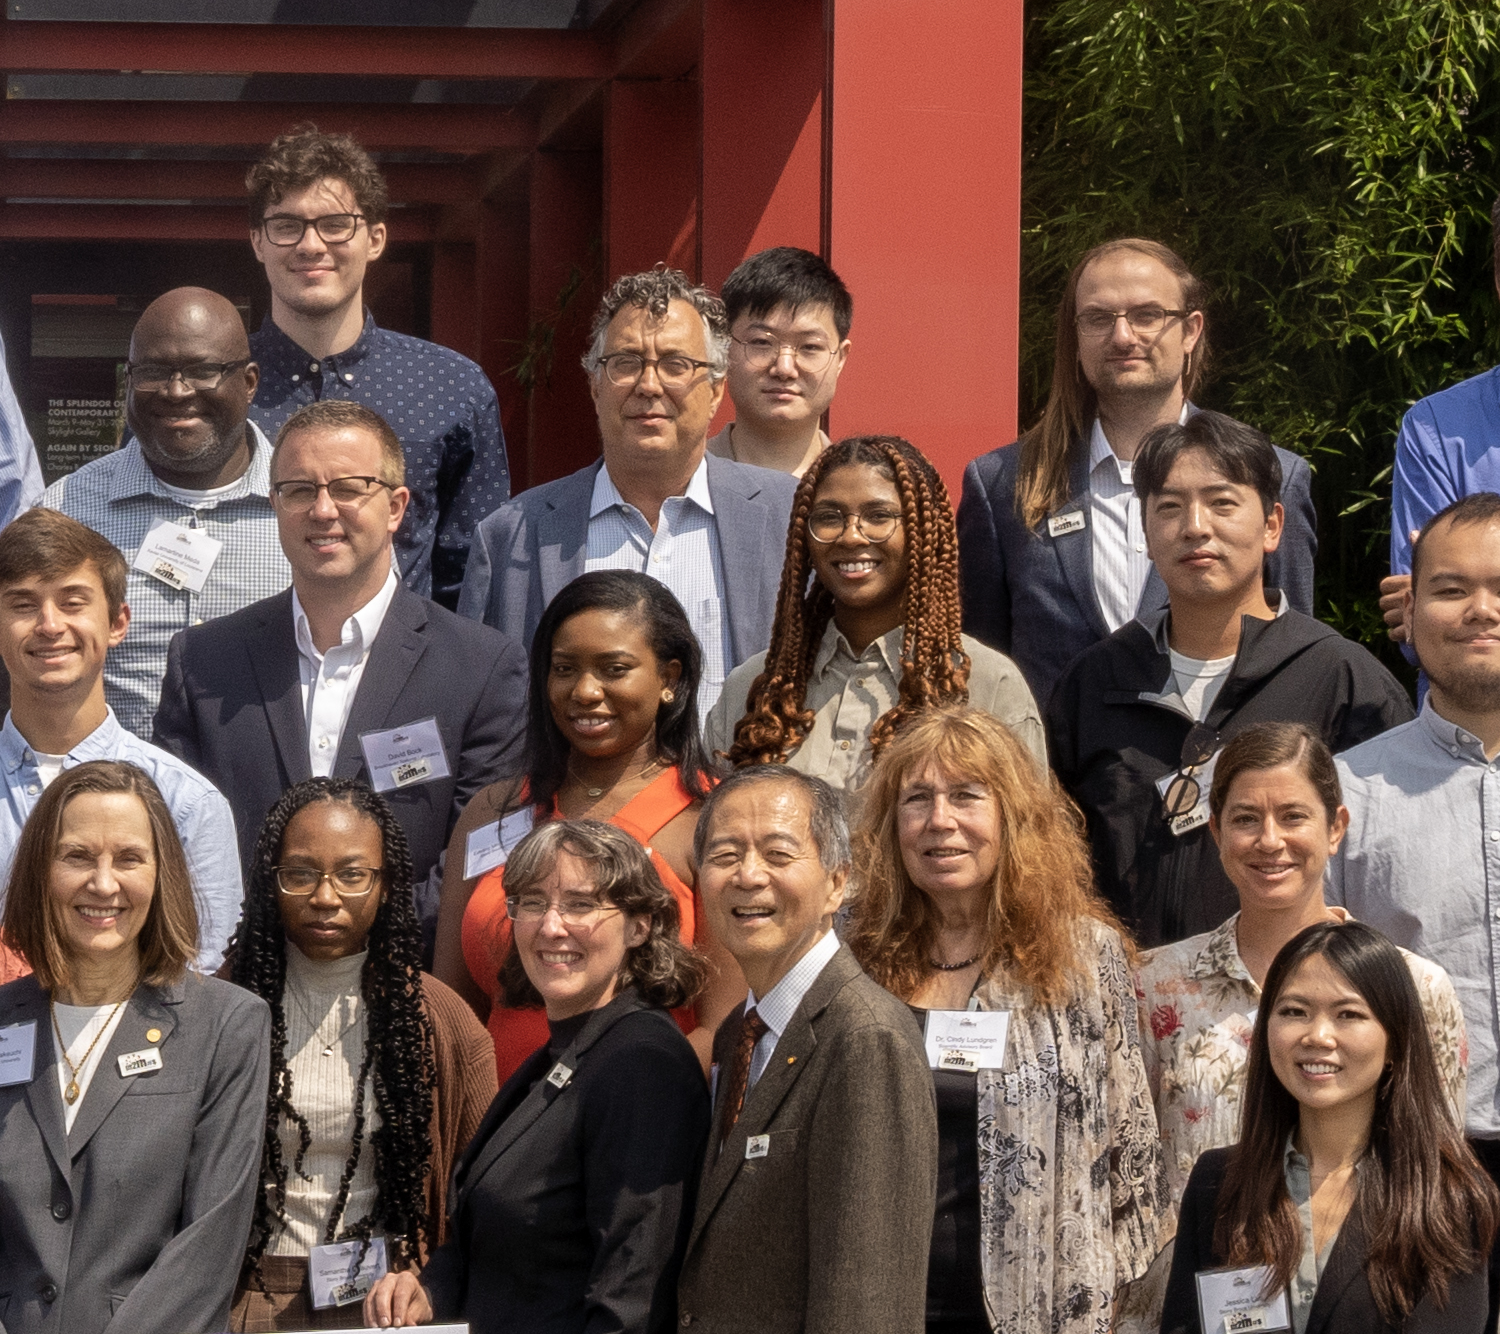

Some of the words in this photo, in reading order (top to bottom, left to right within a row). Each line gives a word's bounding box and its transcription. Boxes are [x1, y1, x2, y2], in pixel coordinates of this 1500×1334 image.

[48, 399, 64, 407] THE
[66, 399, 111, 407] SPLENDOR
[48, 409, 120, 417] CONTEMPORARY
[79, 444, 91, 452] BY
[155, 543, 184, 558] Lamartine
[387, 750, 406, 761] David
[935, 1035, 945, 1043] Dr.
[946, 1036, 966, 1044] Cindy
[966, 1036, 998, 1044] Lundgren
[1224, 1297, 1250, 1307] Jessica
